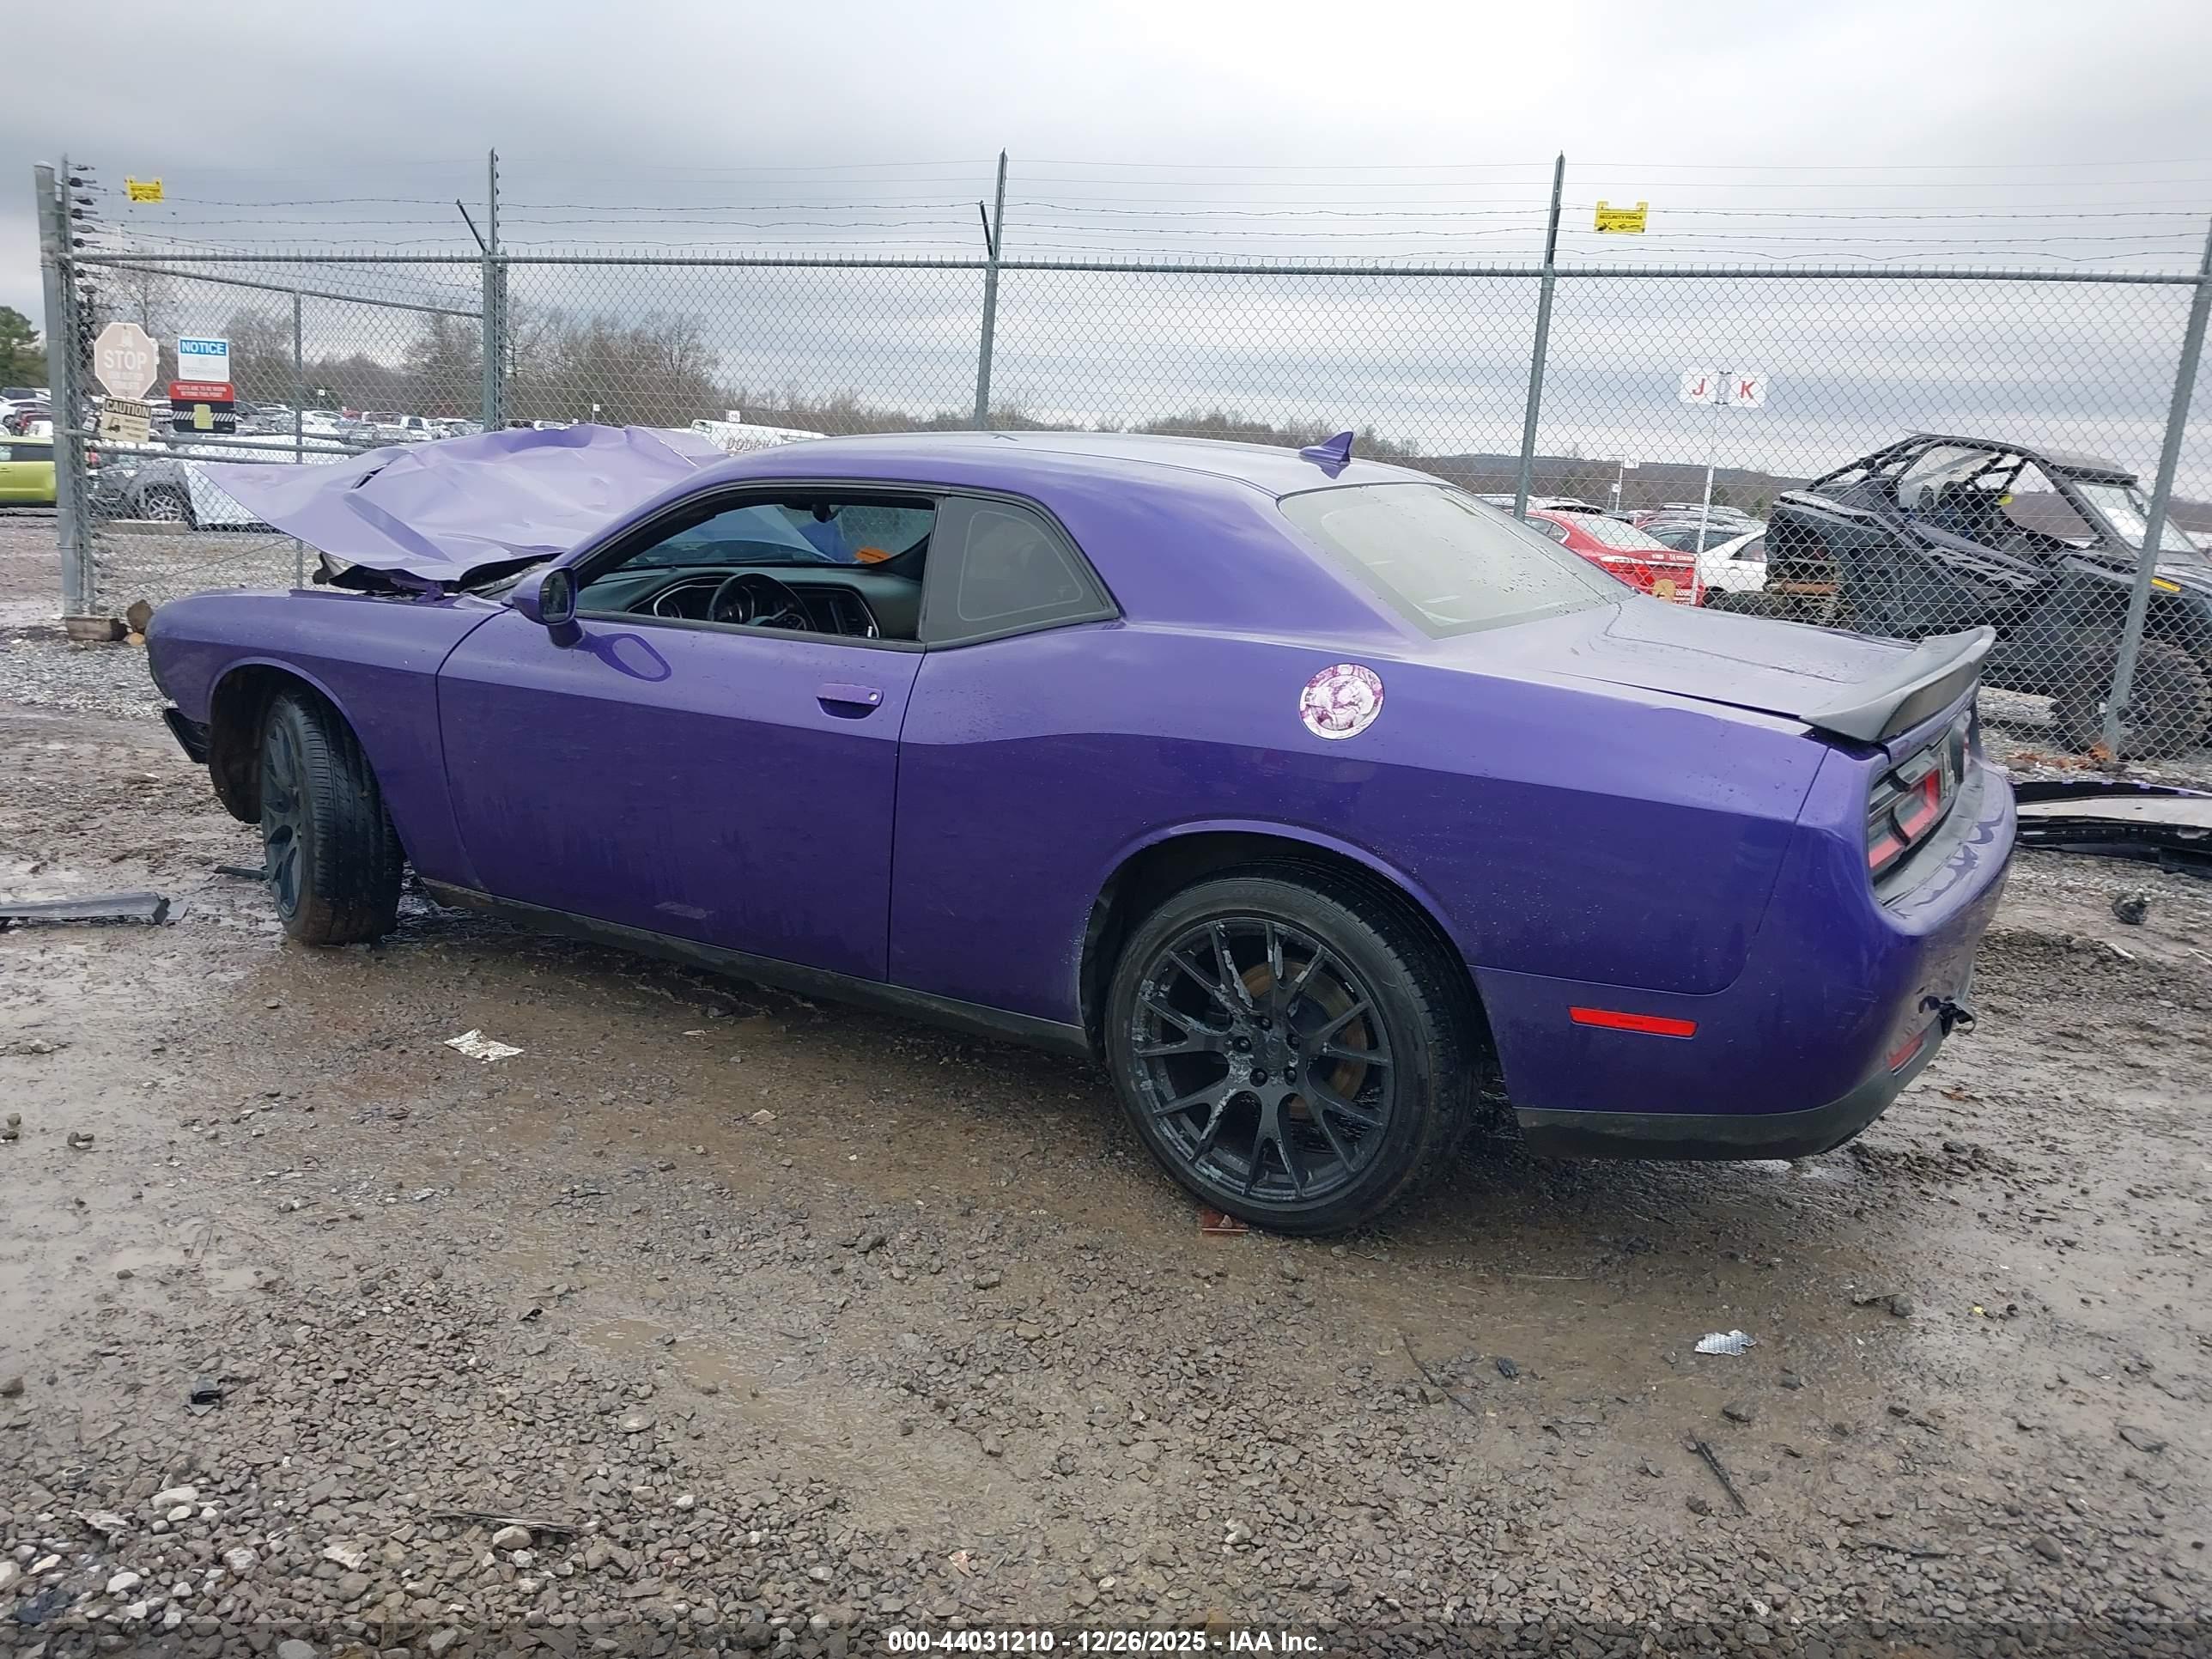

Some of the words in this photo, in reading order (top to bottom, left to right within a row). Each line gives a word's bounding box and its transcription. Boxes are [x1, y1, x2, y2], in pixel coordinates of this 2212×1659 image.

[181, 341, 226, 355] NOTICE
[103, 349, 148, 370] STOP
[1692, 378, 1705, 396] J
[1740, 380, 1756, 399] K
[106, 400, 150, 417] CAUTION
